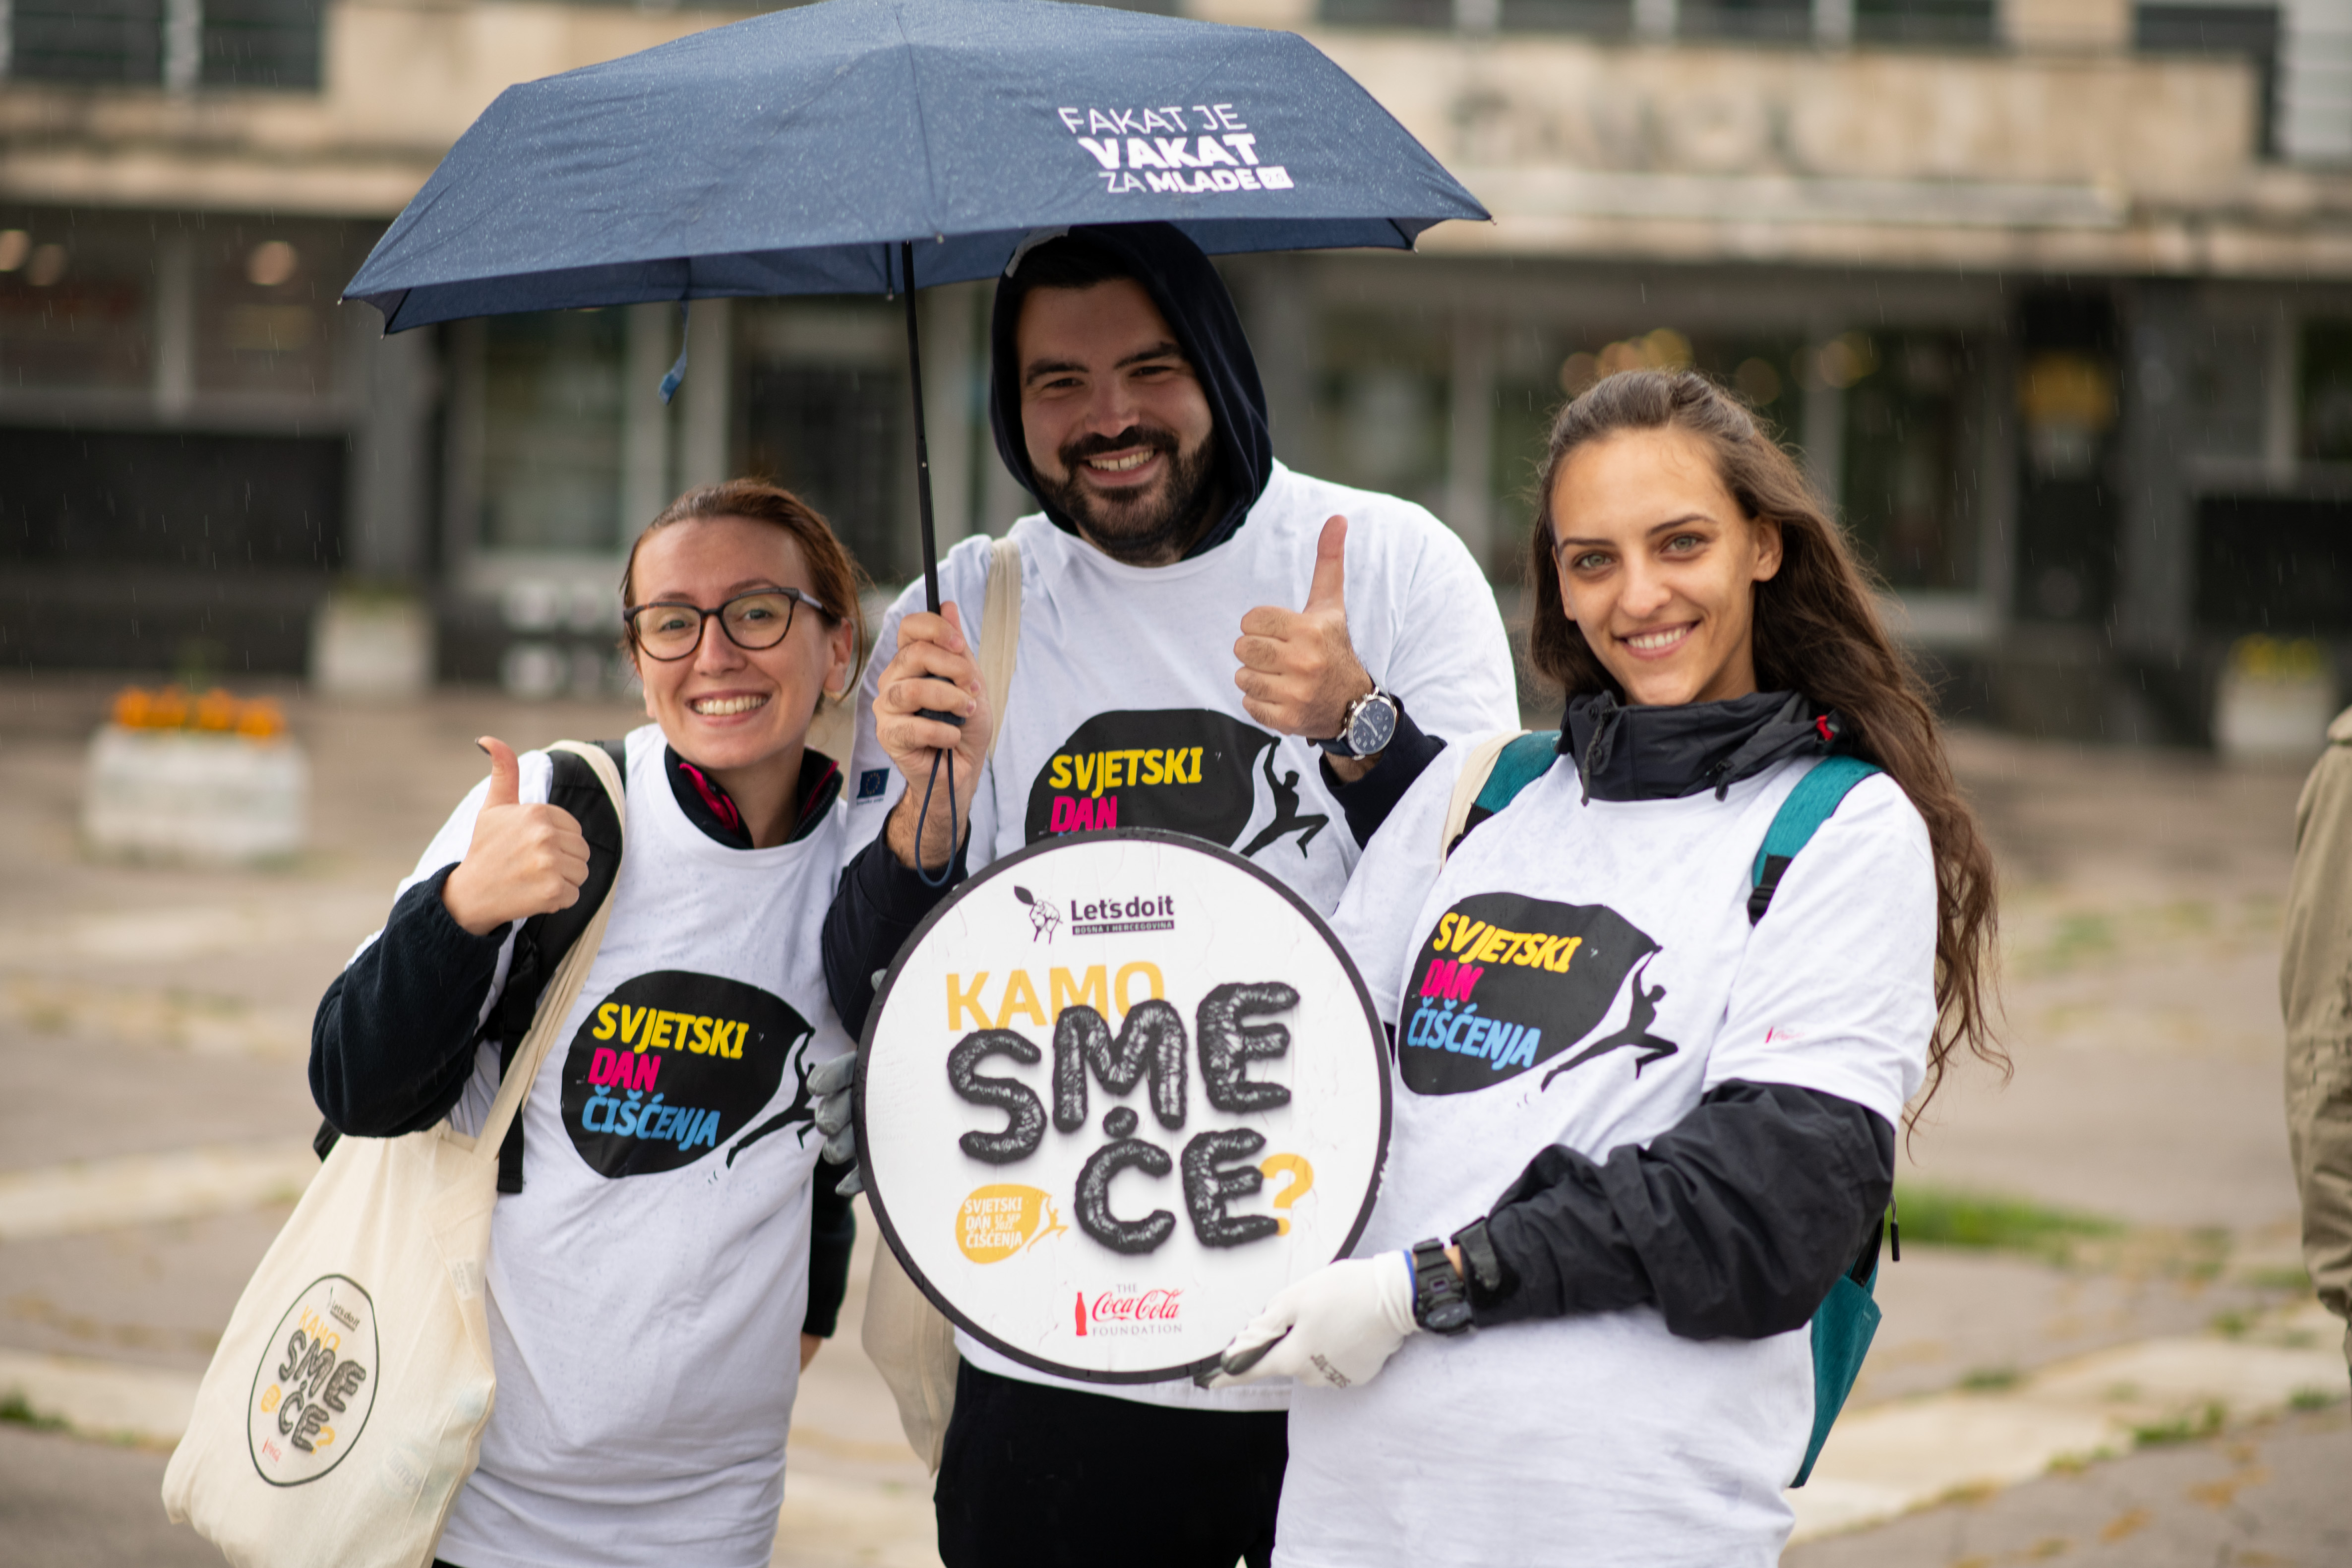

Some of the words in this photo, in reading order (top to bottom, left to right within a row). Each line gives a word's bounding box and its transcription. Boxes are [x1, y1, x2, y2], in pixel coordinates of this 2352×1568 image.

[1058, 107, 1187, 134] FAKAT
[1193, 104, 1247, 130] JE
[1078, 133, 1259, 169] VAKAT
[1098, 171, 1146, 193] ZA
[1145, 169, 1262, 193] MLADE
[1049, 747, 1204, 799] SVJETSKI
[1050, 795, 1117, 832] DAN
[1074, 925, 1104, 935] BOSNA
[1111, 921, 1172, 932] HERCEGOVINA
[1433, 912, 1582, 973] SVJETSKI
[946, 961, 1165, 1031] KAMO
[1420, 959, 1484, 1002] DAN
[593, 1002, 750, 1059] SVJETSKI
[1407, 996, 1541, 1070] ČIŠĆENJA
[588, 1048, 661, 1092] DAN
[947, 981, 1301, 1165] SME
[582, 1084, 721, 1151] ČIŠĆENJA
[964, 1197, 1023, 1216] SVJETSKI
[965, 1215, 991, 1231] DAN
[965, 1229, 1023, 1250] ČIŠĆENJA
[1116, 1283, 1137, 1293] THE
[299, 1305, 341, 1352] KAMO
[1092, 1324, 1182, 1336] FOUNDATION
[279, 1328, 366, 1412] SME
